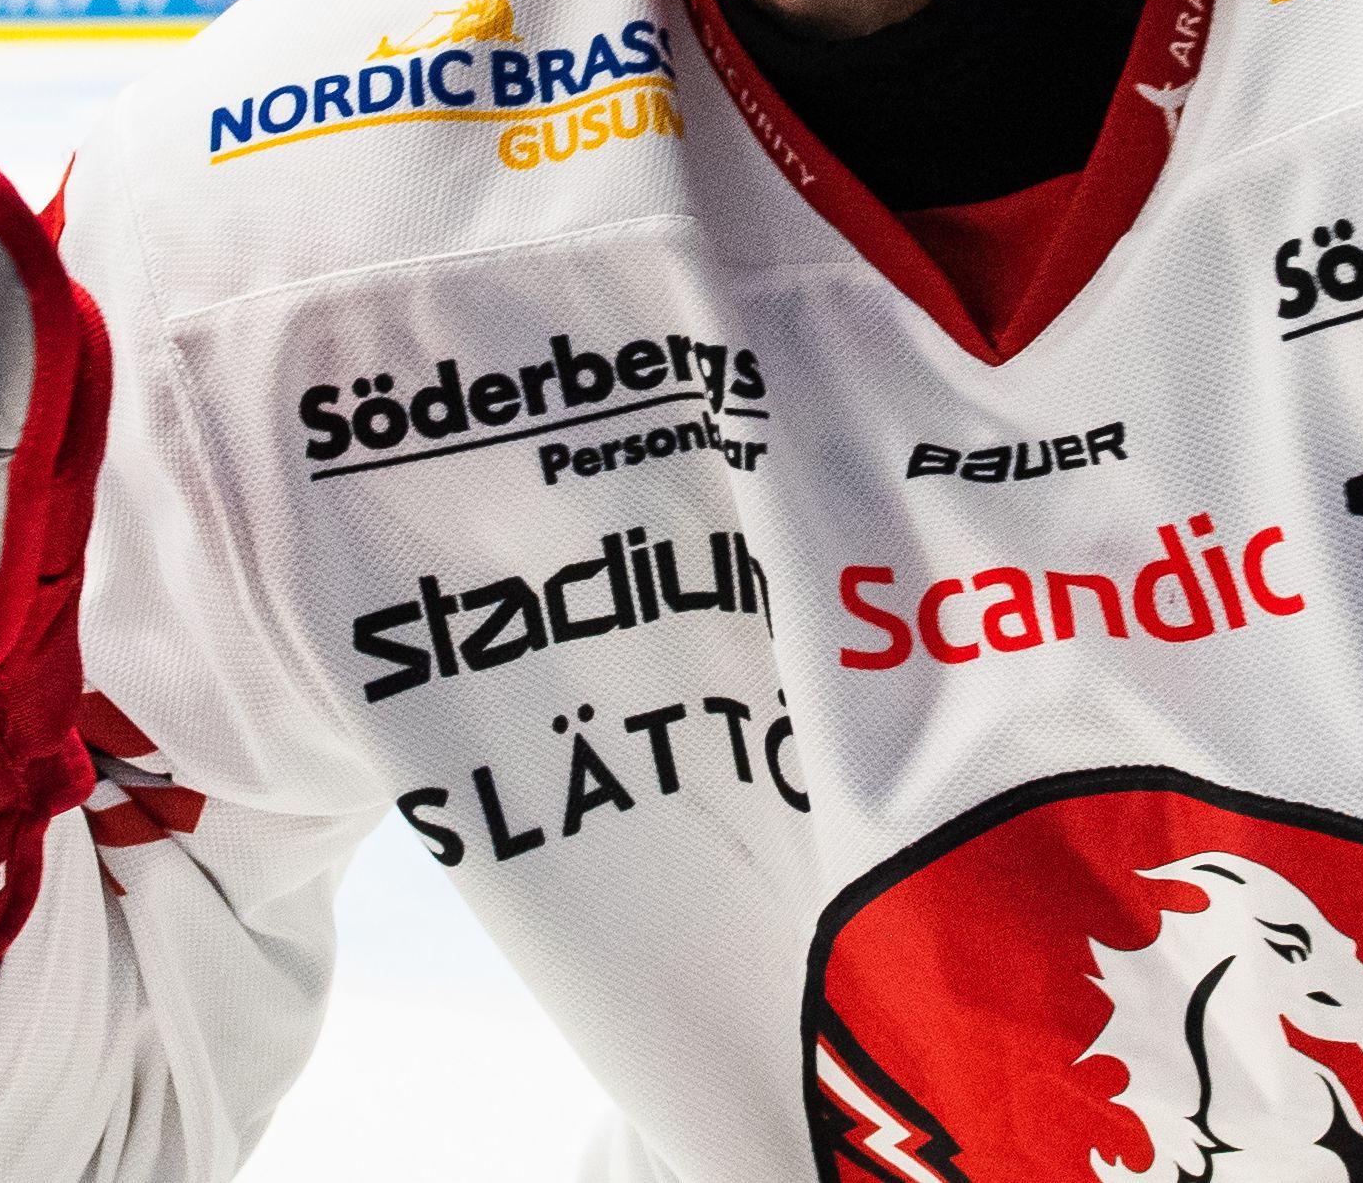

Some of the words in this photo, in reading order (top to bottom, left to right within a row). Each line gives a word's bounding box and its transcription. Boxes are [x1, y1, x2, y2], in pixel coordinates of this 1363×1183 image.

[209, 49, 476, 153] NORDIC
[298, 333, 767, 461] Söderbergs
[906, 421, 1128, 484] BAUER
[838, 512, 1306, 671] Scandic
